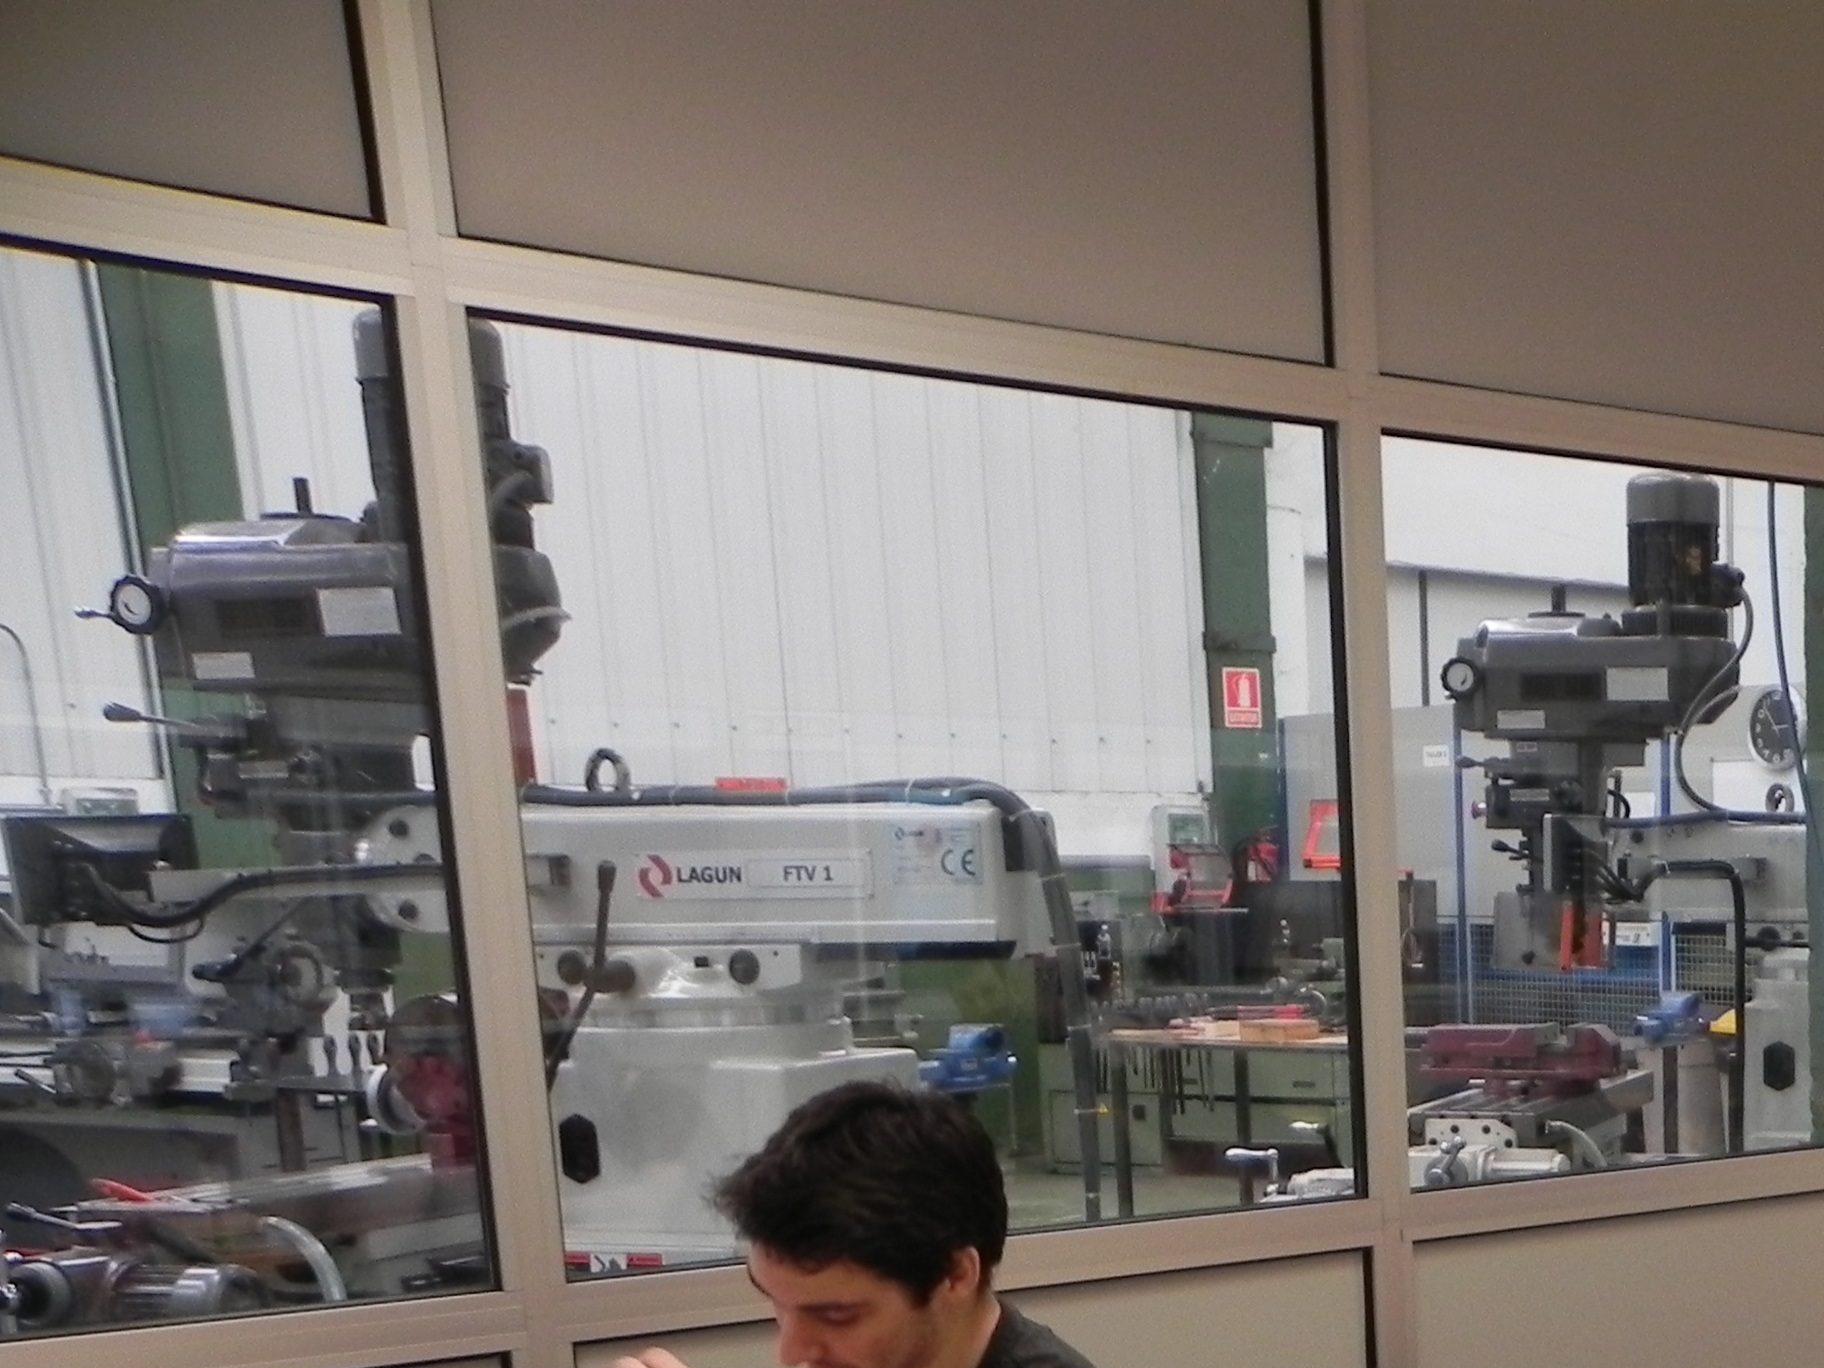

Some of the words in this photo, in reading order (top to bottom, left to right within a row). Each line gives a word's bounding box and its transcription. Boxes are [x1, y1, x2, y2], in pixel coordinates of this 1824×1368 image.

[676, 866, 742, 884] LAGUN
[783, 865, 816, 882] FTV
[823, 865, 834, 882] 1
